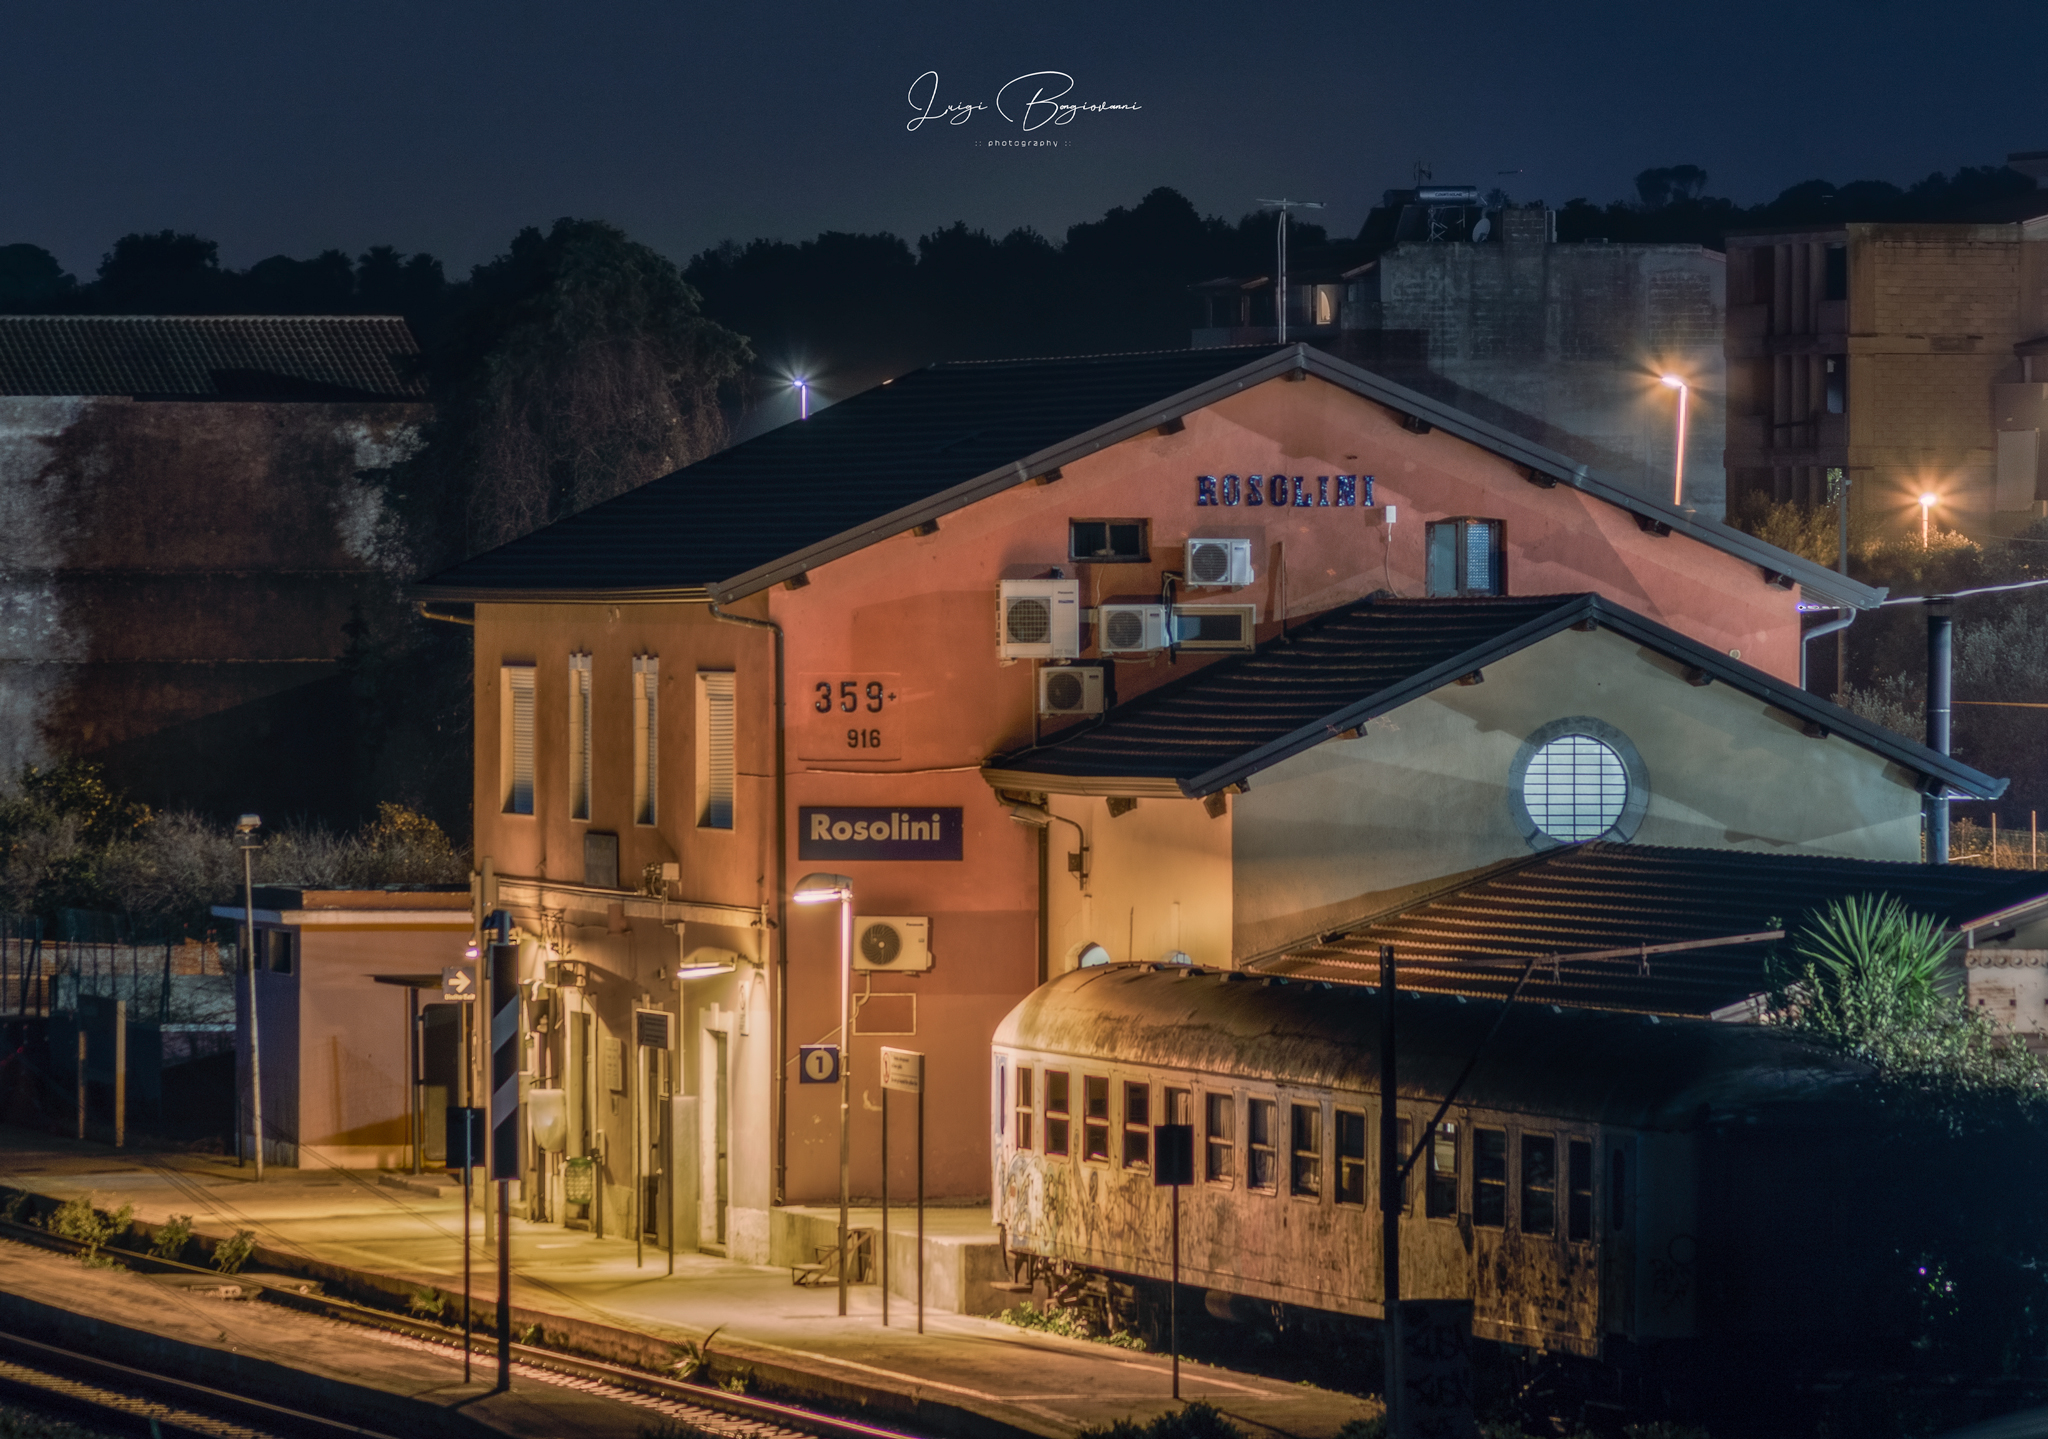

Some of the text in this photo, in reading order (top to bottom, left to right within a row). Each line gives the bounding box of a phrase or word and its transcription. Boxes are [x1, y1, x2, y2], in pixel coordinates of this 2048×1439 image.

[1197, 474, 1375, 507] ROSOLINI
[847, 728, 881, 749] 916
[811, 812, 941, 841] Rosolini
[815, 1056, 823, 1074] 1
